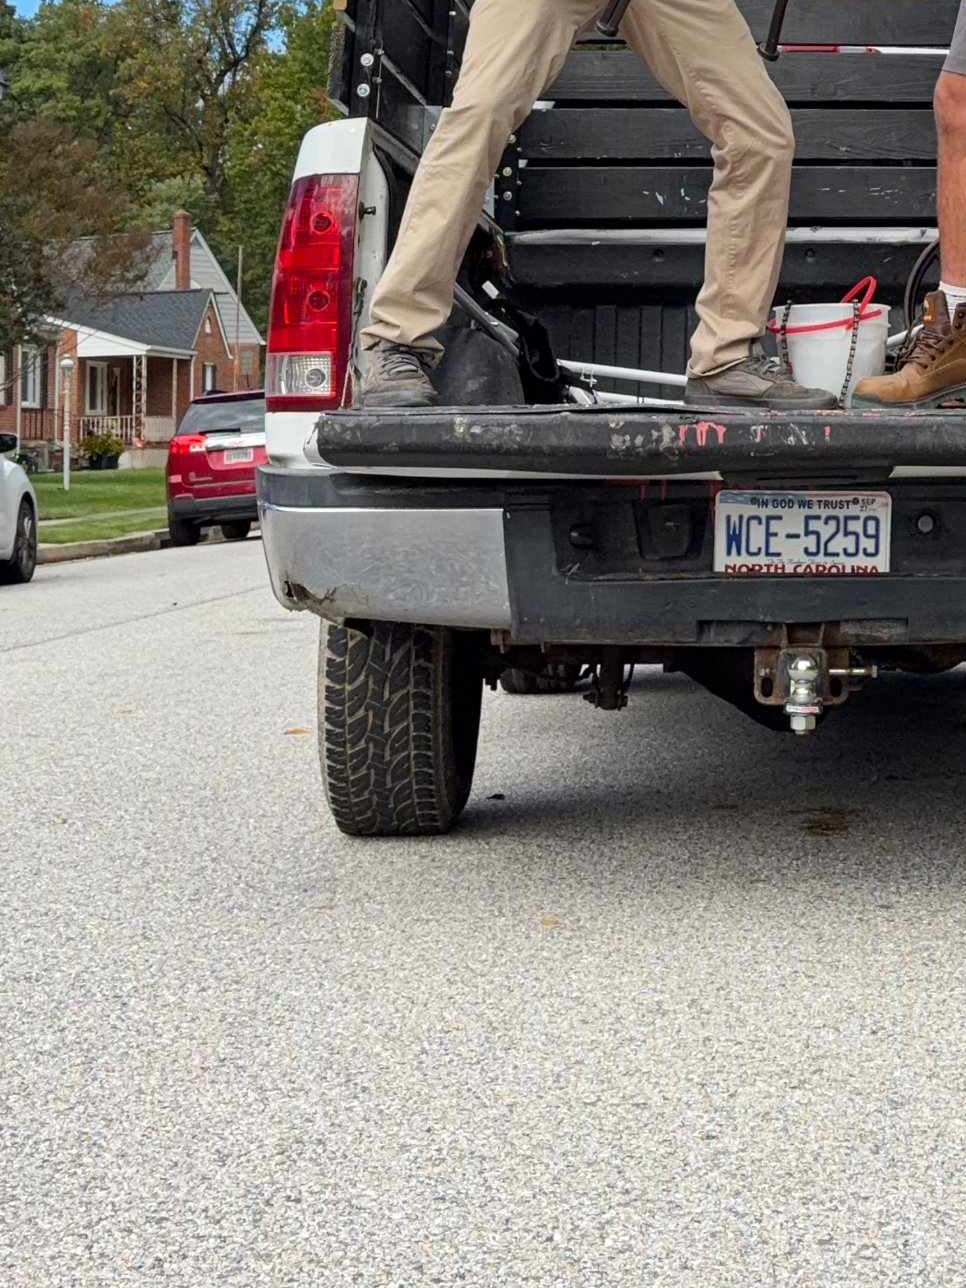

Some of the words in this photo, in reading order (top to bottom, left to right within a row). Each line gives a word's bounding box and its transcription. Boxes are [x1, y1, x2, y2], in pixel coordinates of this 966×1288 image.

[757, 498, 769, 509] IN
[772, 498, 795, 509] GOD
[797, 499, 814, 510] WE
[817, 499, 852, 510] TRUST
[725, 514, 881, 558] WCE-5259
[724, 564, 786, 574] NORTH
[793, 564, 879, 574] CAROLINA
